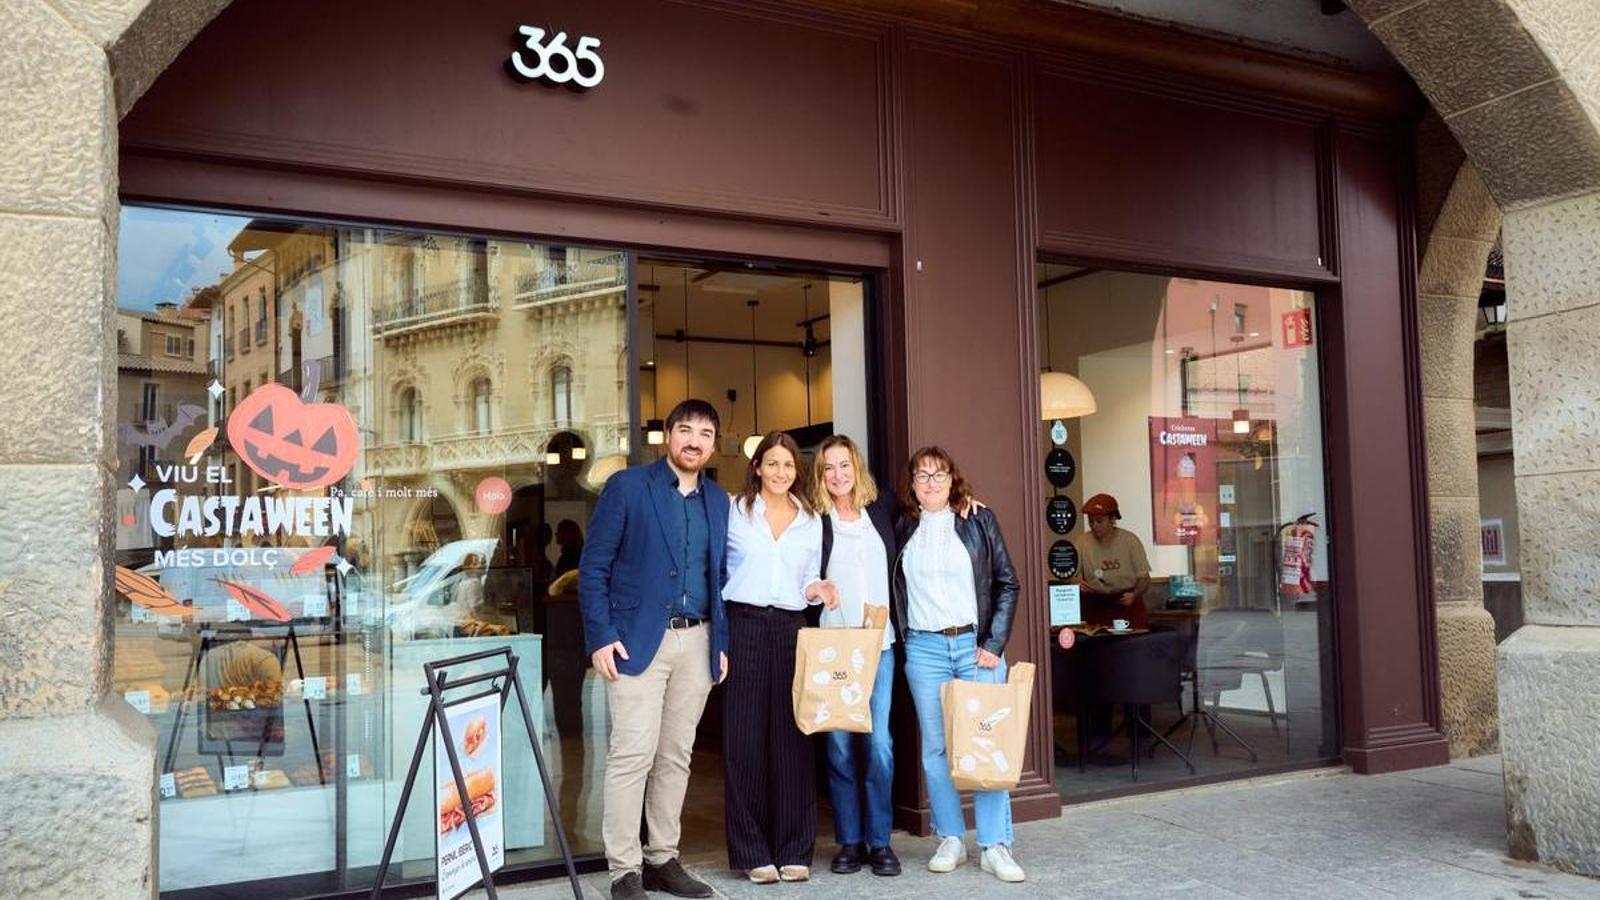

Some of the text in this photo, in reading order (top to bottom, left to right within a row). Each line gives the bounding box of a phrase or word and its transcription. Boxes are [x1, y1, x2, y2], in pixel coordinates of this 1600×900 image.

[511, 25, 605, 88] 365
[206, 465, 233, 484] EL
[385, 485, 412, 498] molt
[415, 485, 438, 498] més
[151, 488, 354, 538] CASTAWEEN
[154, 544, 279, 570] MÉS DOLÇ
[1102, 558, 1121, 571] 365
[832, 671, 848, 681] 365
